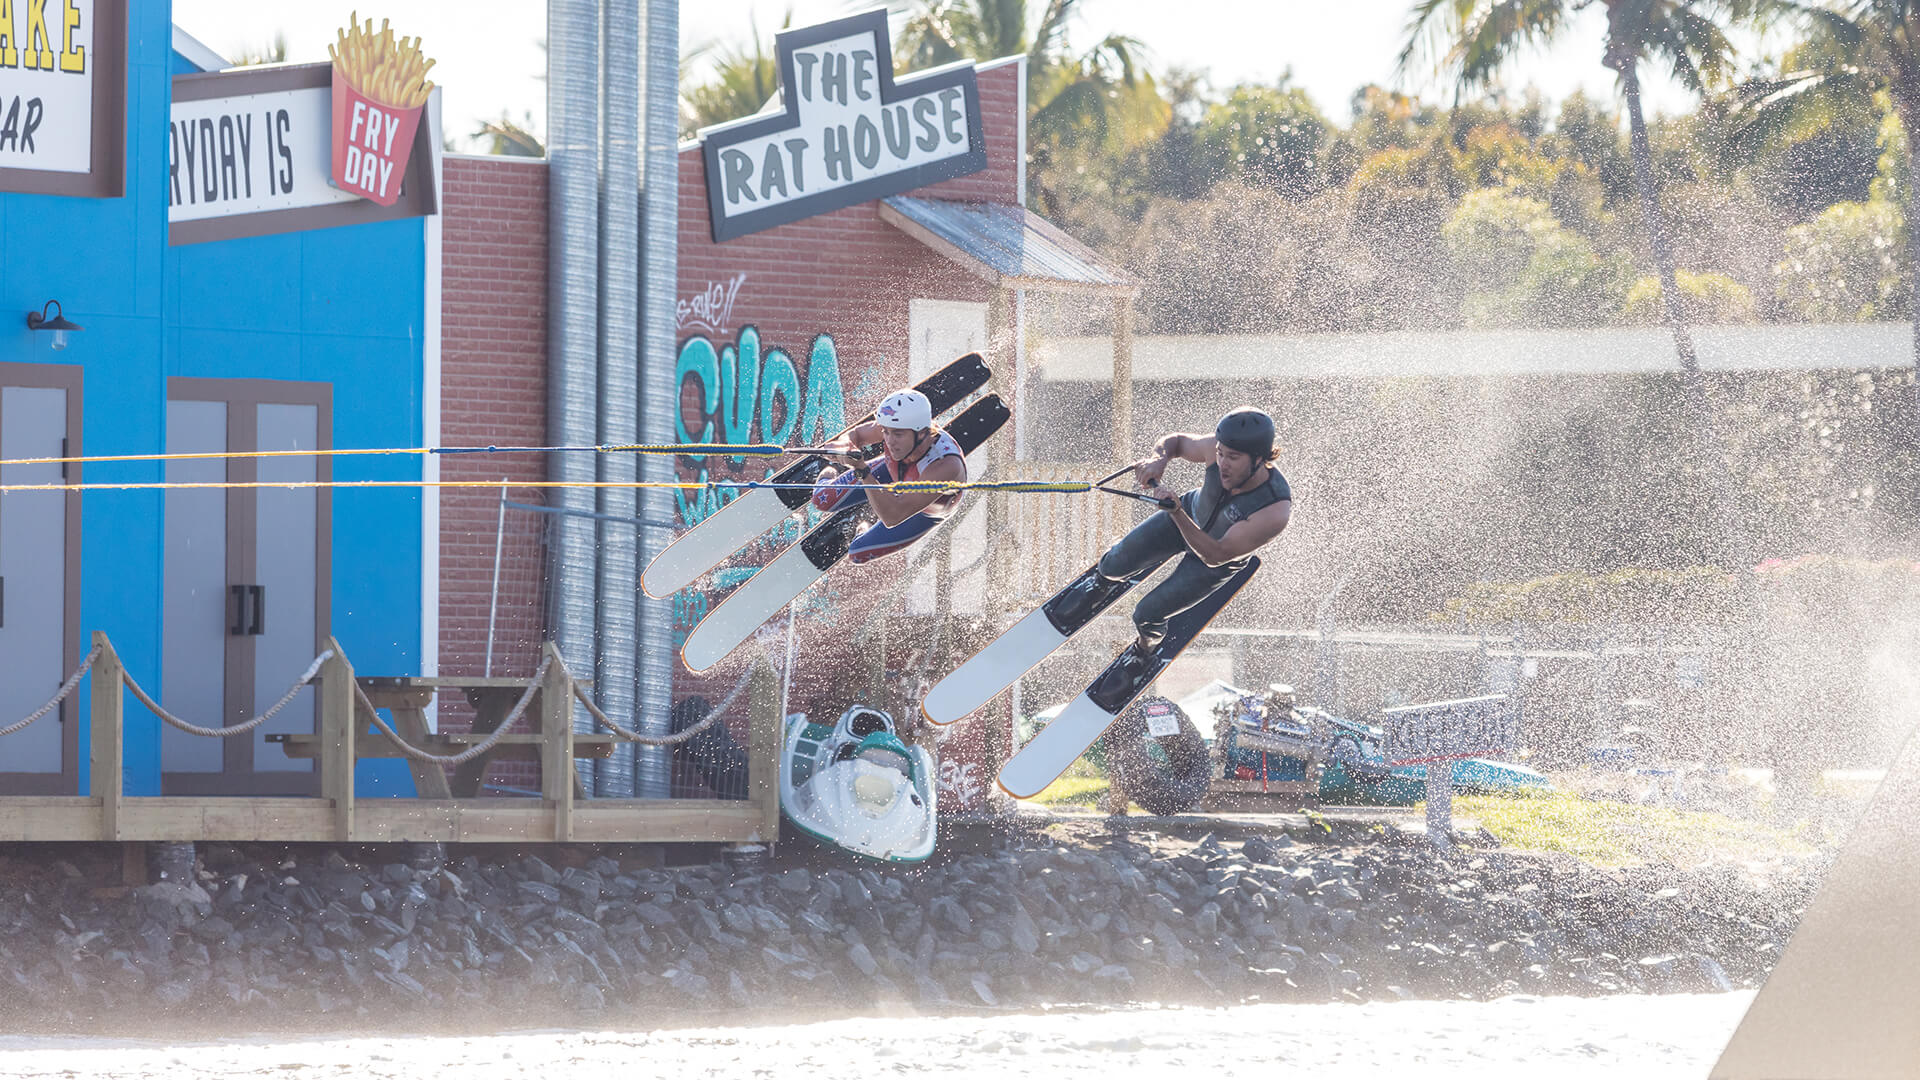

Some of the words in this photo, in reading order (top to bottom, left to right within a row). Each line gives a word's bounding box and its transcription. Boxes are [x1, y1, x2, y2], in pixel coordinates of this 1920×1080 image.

[795, 50, 874, 106] THE
[266, 109, 294, 195] IS
[350, 101, 400, 157] FRY
[720, 137, 808, 205] RAT
[823, 88, 963, 182] HOUSE
[344, 144, 394, 198] DAY
